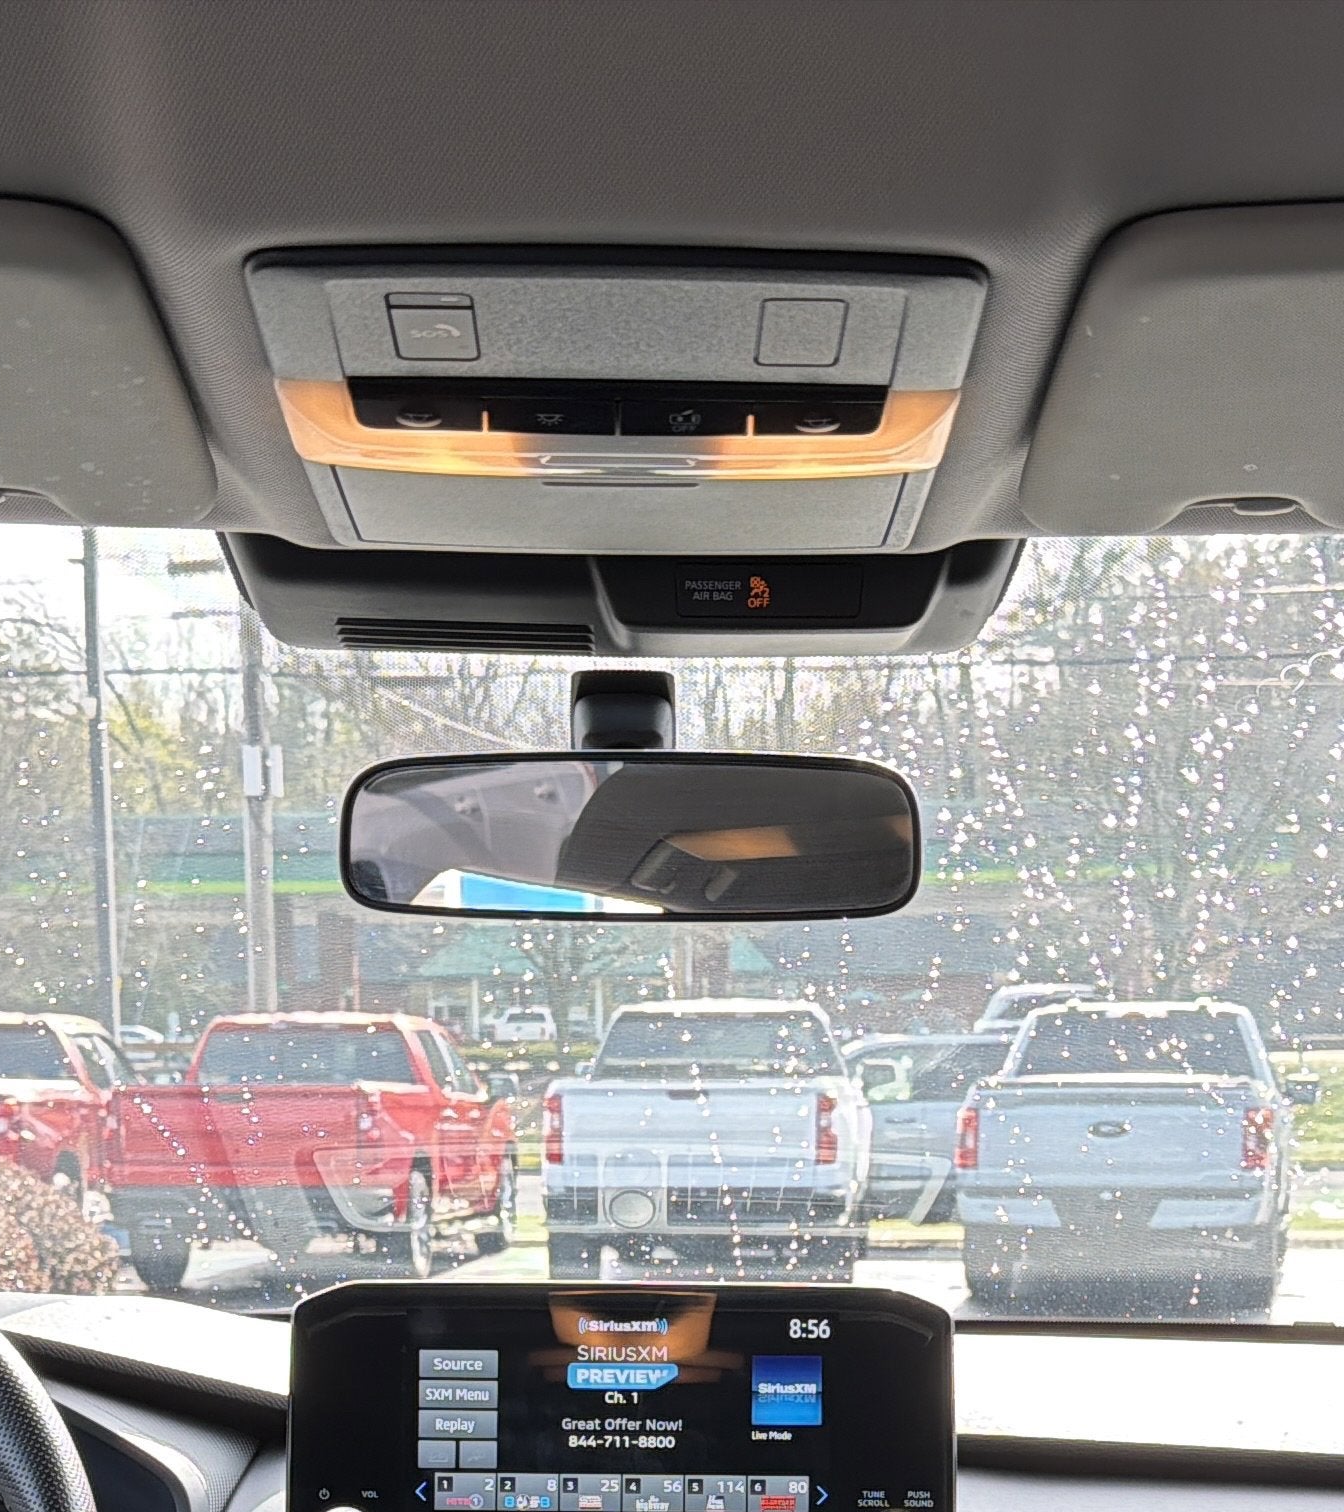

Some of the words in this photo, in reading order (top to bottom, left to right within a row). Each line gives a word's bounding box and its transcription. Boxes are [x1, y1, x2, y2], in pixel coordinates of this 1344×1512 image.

[684, 580, 742, 591] PASSENGER
[692, 591, 710, 601] AIR
[712, 591, 734, 601] BAG
[747, 598, 770, 609] OFF
[788, 1318, 831, 1339] 8:56
[577, 1344, 668, 1362] SIRIUSXM
[433, 1358, 483, 1371] Source
[576, 1368, 668, 1385] PREVIEW
[425, 1387, 453, 1401] SXM
[456, 1388, 490, 1401] Menu
[604, 1391, 626, 1405] Ch.
[631, 1391, 639, 1405] 1
[435, 1418, 475, 1435] Replay
[561, 1418, 601, 1431] Great
[604, 1417, 642, 1431] Offer
[645, 1418, 683, 1431] Now!
[568, 1435, 676, 1449] 844-711-8800
[751, 1431, 768, 1441] Live
[768, 1431, 793, 1441] Mode
[442, 1480, 448, 1489] 1
[484, 1478, 495, 1491] 2
[503, 1480, 512, 1490] 2
[546, 1479, 558, 1492] 8
[566, 1481, 575, 1491] 3
[600, 1479, 620, 1492] 25
[629, 1481, 637, 1492] 4
[663, 1479, 682, 1493] 56
[691, 1481, 699, 1492] 5
[716, 1480, 745, 1493] 114
[754, 1482, 762, 1492] 6
[788, 1481, 808, 1494] 80
[361, 1490, 379, 1499] VOL
[861, 1490, 886, 1499] TUNE
[907, 1490, 931, 1499] PUSH
[857, 1499, 891, 1508] SCROLL
[903, 1499, 934, 1508] SOUND
